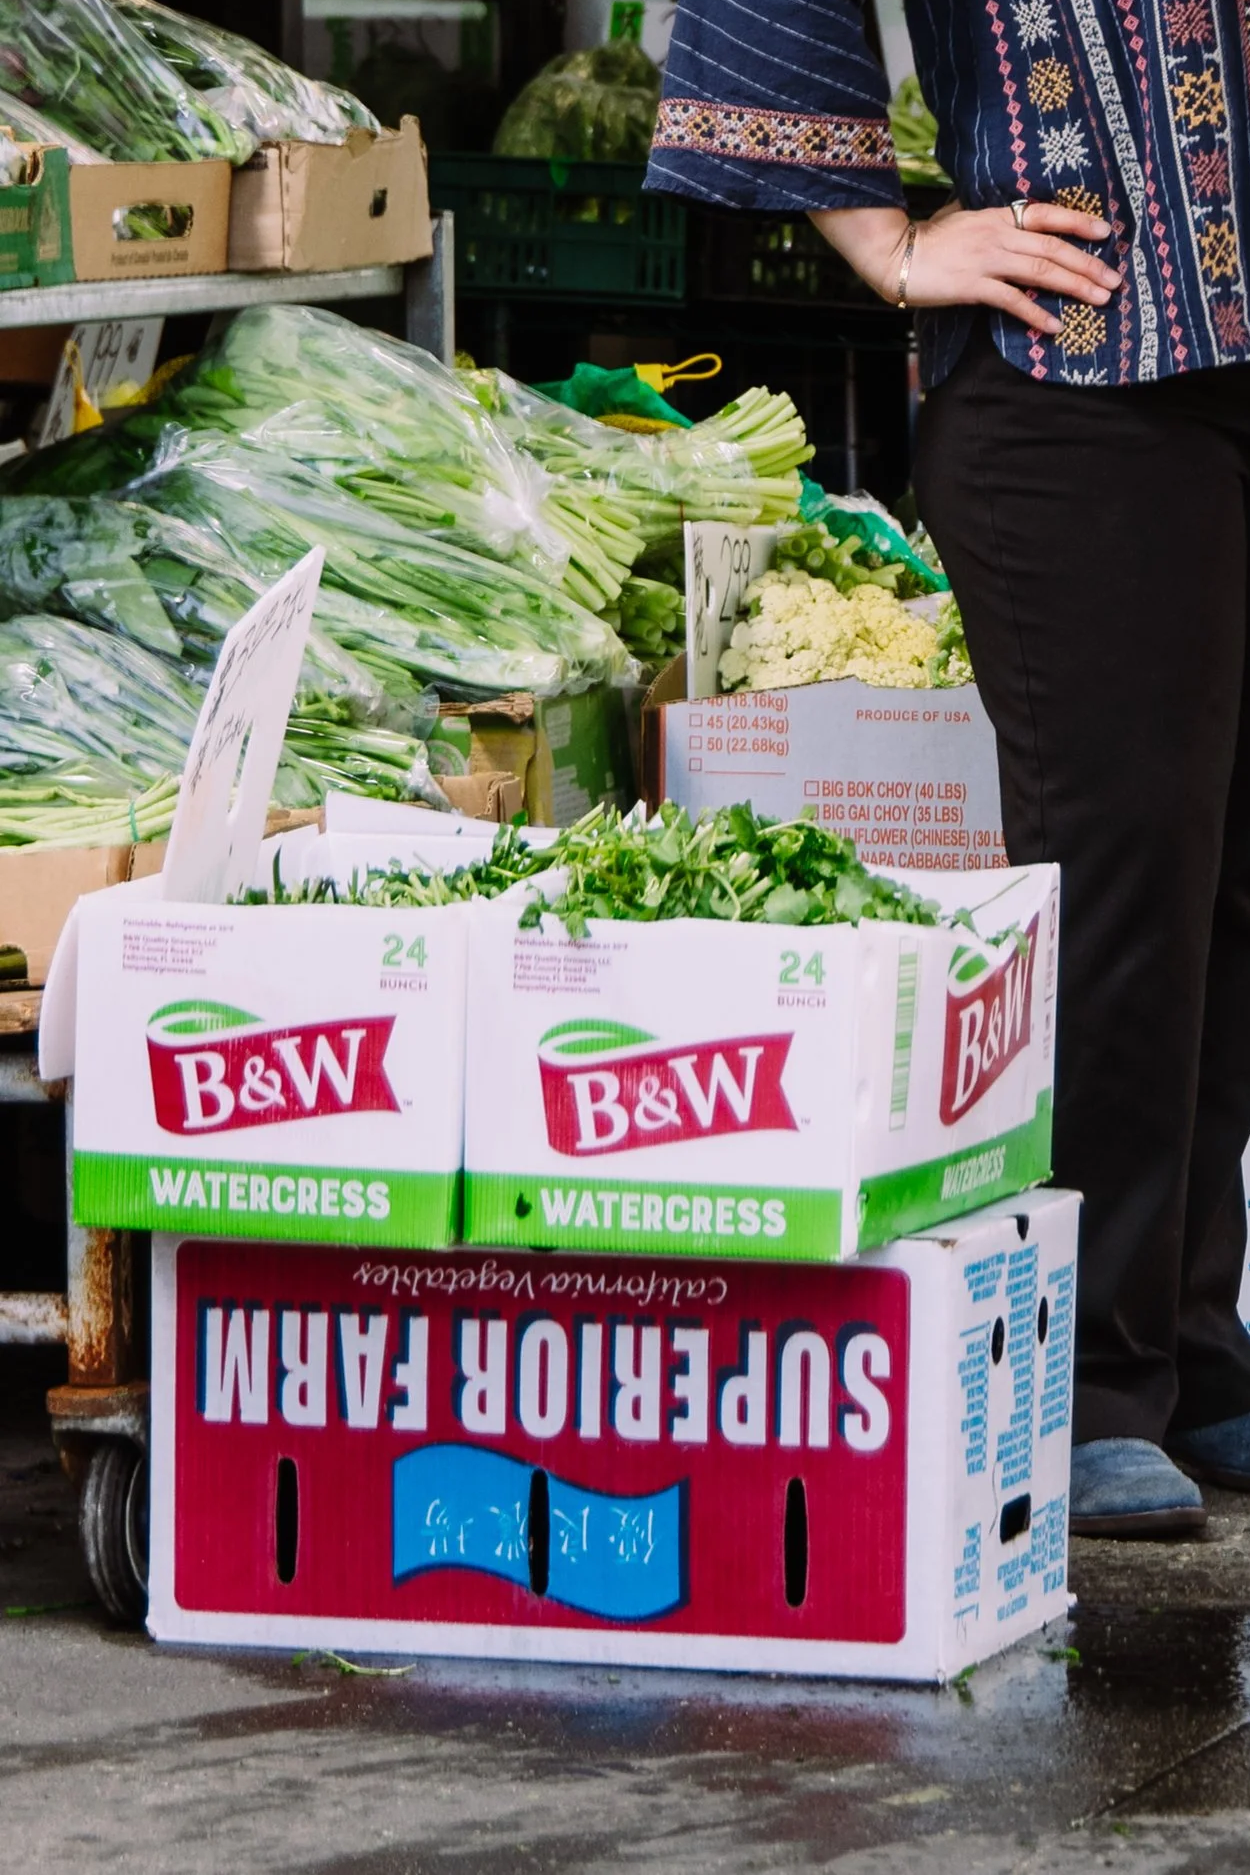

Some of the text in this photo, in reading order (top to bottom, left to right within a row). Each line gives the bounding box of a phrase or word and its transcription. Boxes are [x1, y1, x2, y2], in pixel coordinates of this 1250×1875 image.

[719, 535, 751, 622] 299
[707, 714, 789, 733] 45 (20.43kg)
[856, 709, 970, 722] PRODUCE OF USA
[707, 736, 789, 756] 50 (22.68kg)
[822, 781, 967, 803] BIG BOK CHOY (40 LBS)
[823, 805, 963, 826] BIG GAI CHOY (35 LBS)
[911, 828, 990, 849] (CHINESE) (30
[861, 851, 893, 868] NAPA
[900, 853, 959, 870] CABBAGE
[963, 854, 982, 870] (50
[383, 934, 428, 968] 24
[778, 951, 826, 984] 24
[379, 979, 428, 991] BUNCH
[777, 996, 826, 1008] BUNCH
[951, 934, 1033, 1114] B&W
[174, 1028, 366, 1130] B&W
[567, 1046, 764, 1150] B&W
[941, 1144, 1006, 1202] WATERCRESS
[149, 1168, 391, 1220] WATERCRESS
[540, 1188, 787, 1239] WATERCRESS
[352, 1259, 728, 1306] California Vegetables
[202, 1307, 429, 1431] FARM
[458, 1318, 891, 1451] SUPERIOR
